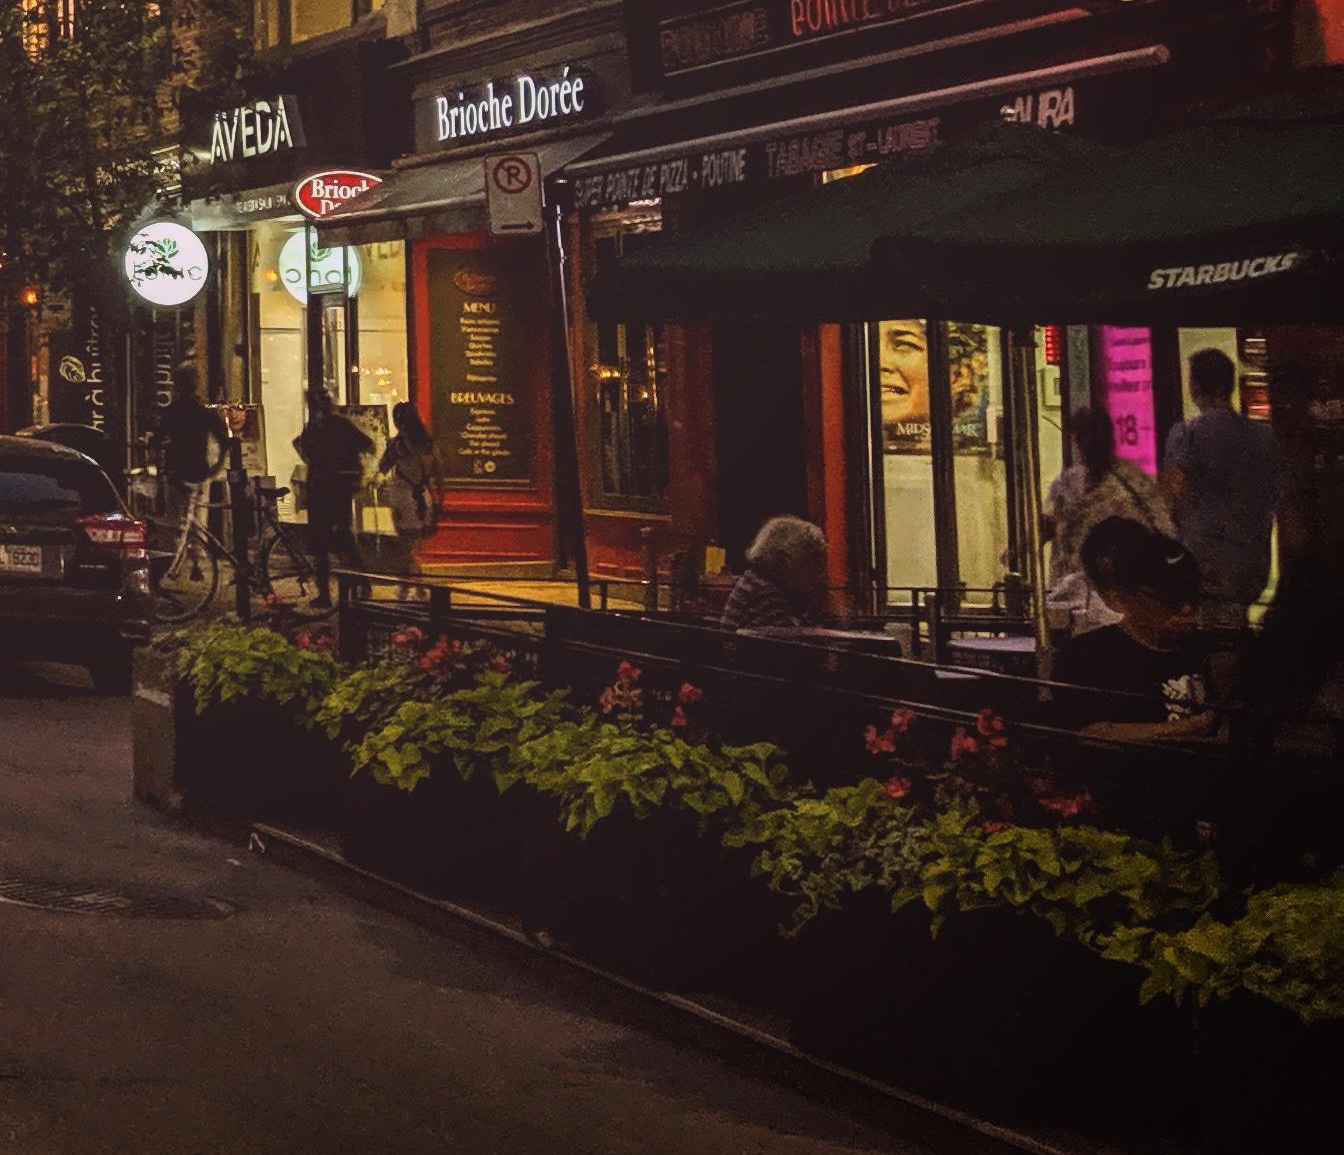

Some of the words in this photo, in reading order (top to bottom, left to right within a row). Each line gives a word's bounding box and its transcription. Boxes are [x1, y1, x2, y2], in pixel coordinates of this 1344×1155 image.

[211, 95, 293, 165] AVEDA
[437, 82, 513, 141] Brioche
[518, 66, 584, 124] Dorée
[1146, 251, 1300, 291] STARBUCKS
